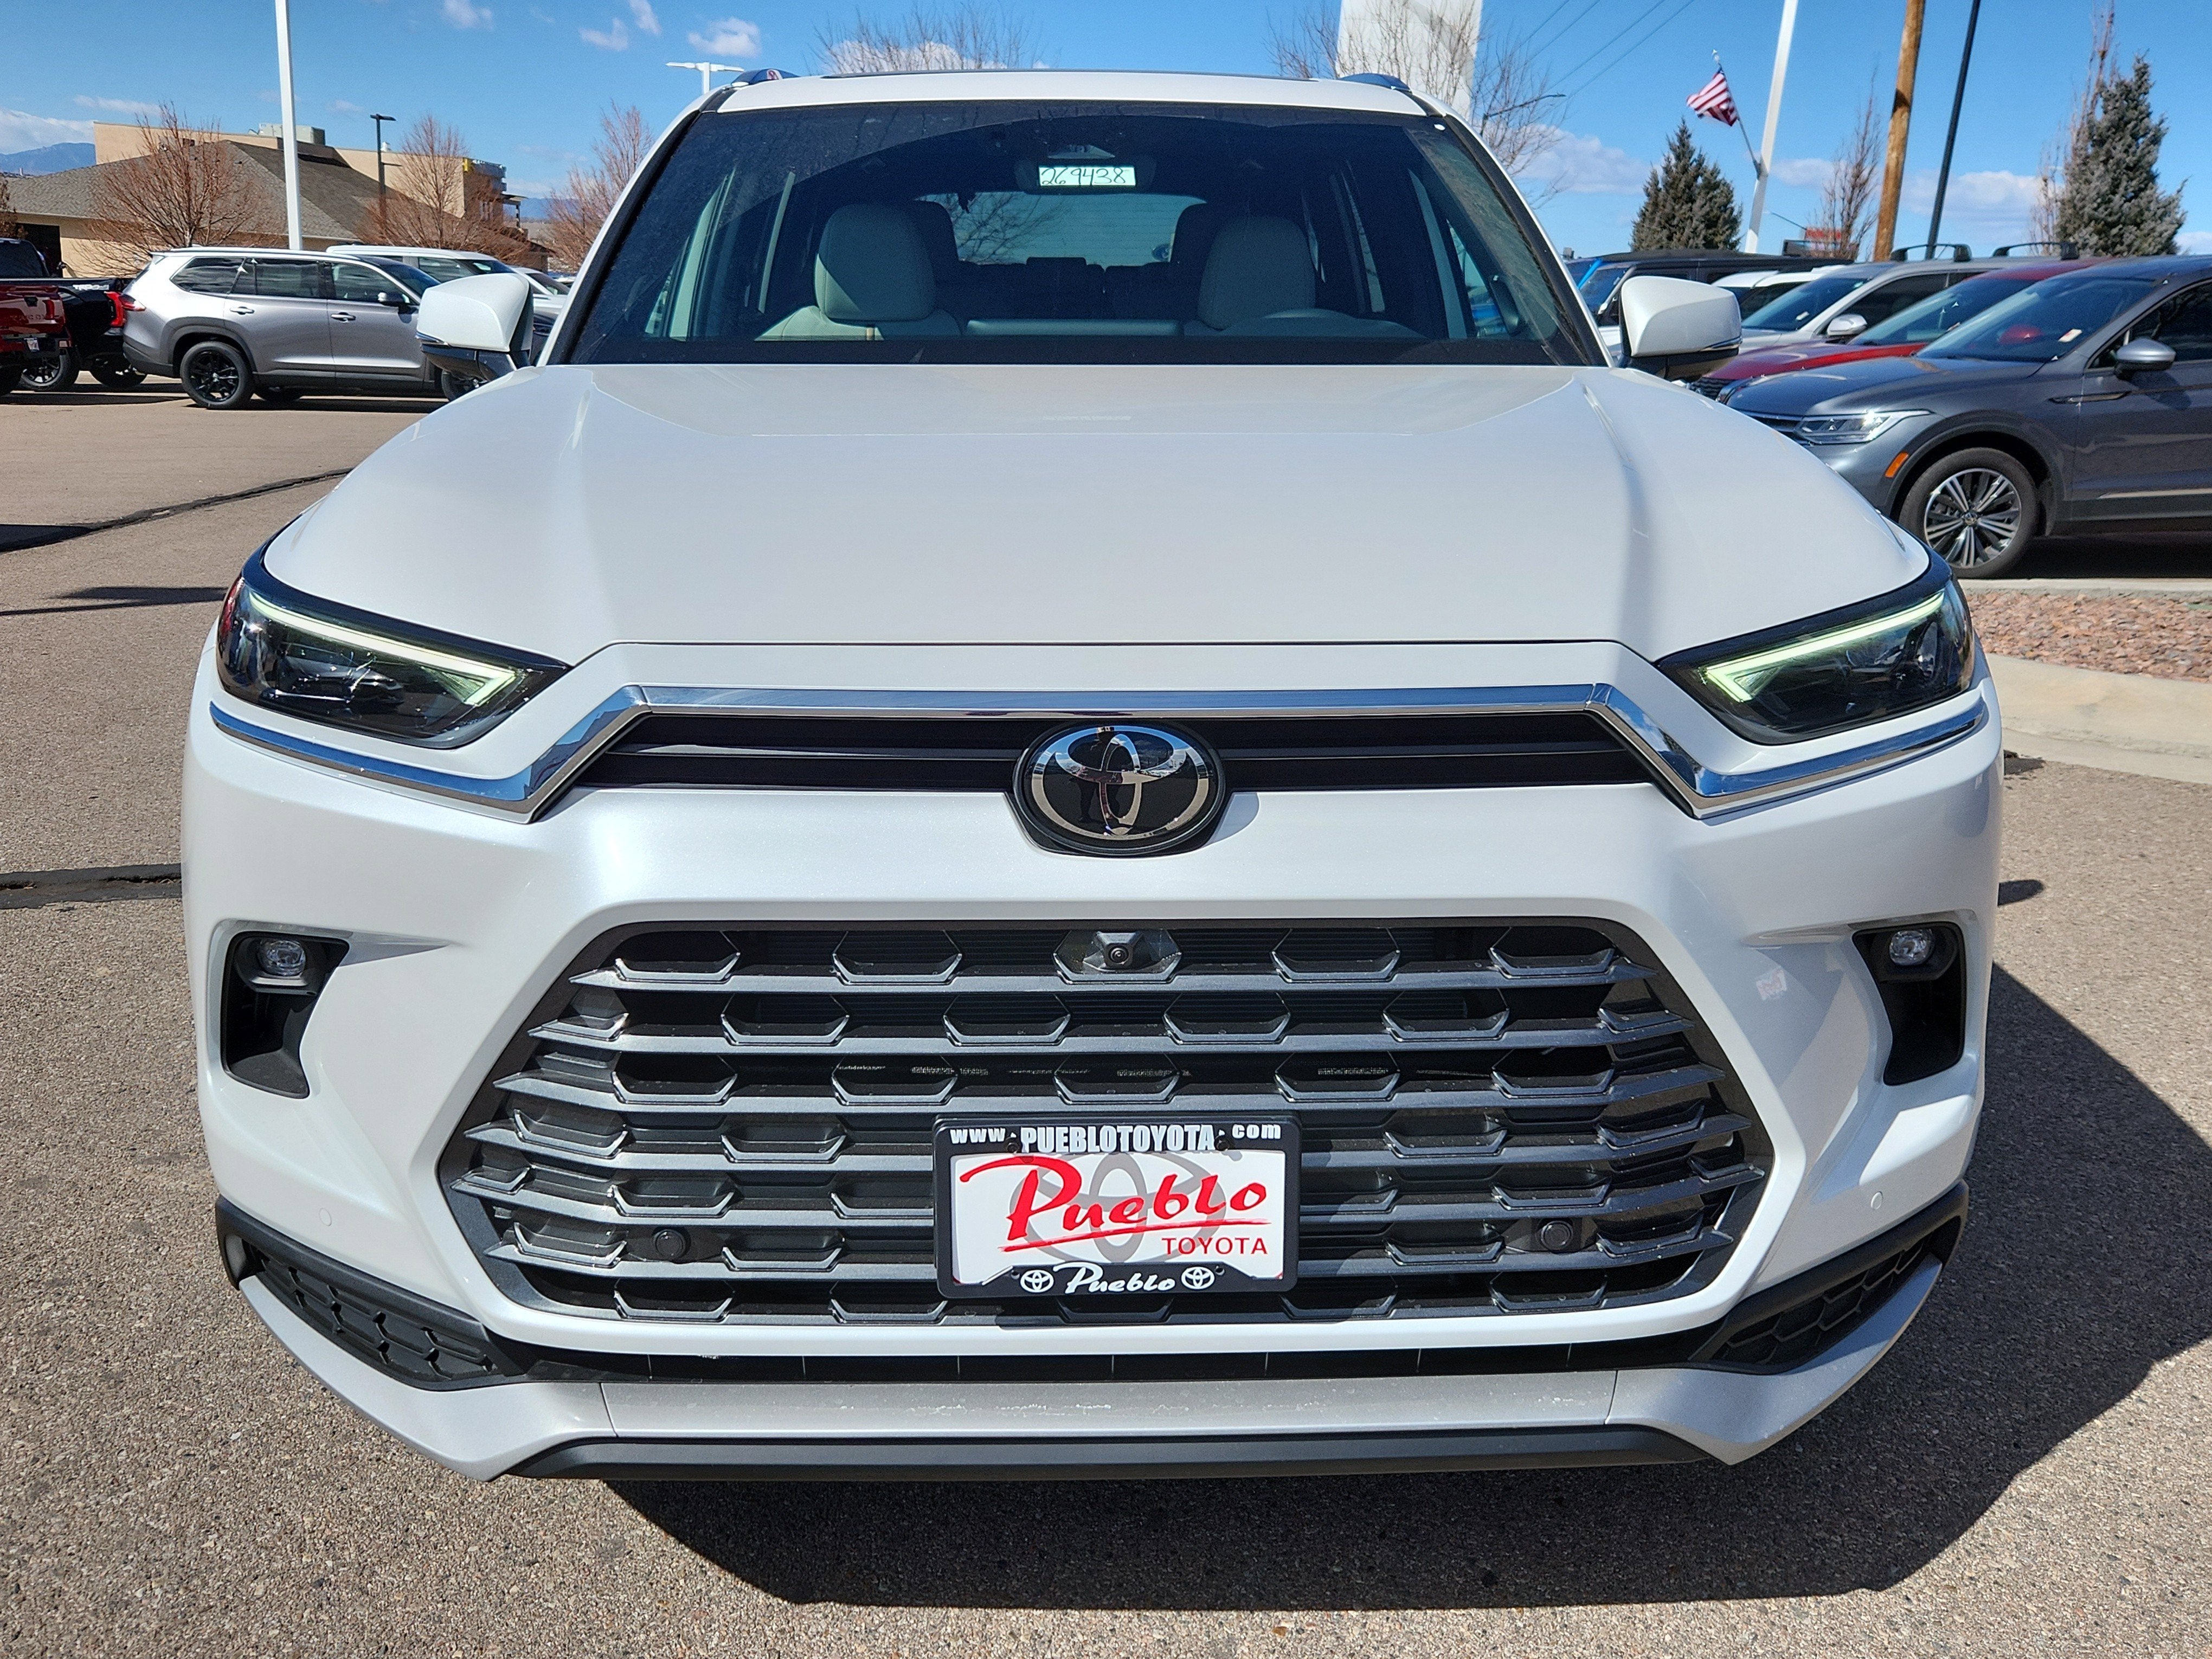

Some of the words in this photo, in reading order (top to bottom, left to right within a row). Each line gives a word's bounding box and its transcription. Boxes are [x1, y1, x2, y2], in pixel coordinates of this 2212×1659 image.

[1041, 167, 1126, 185] 269438
[960, 1155, 1266, 1240] Pueblo
[1161, 1237, 1268, 1255] TOYOTA
[1053, 1262, 1175, 1294] Pueblo
